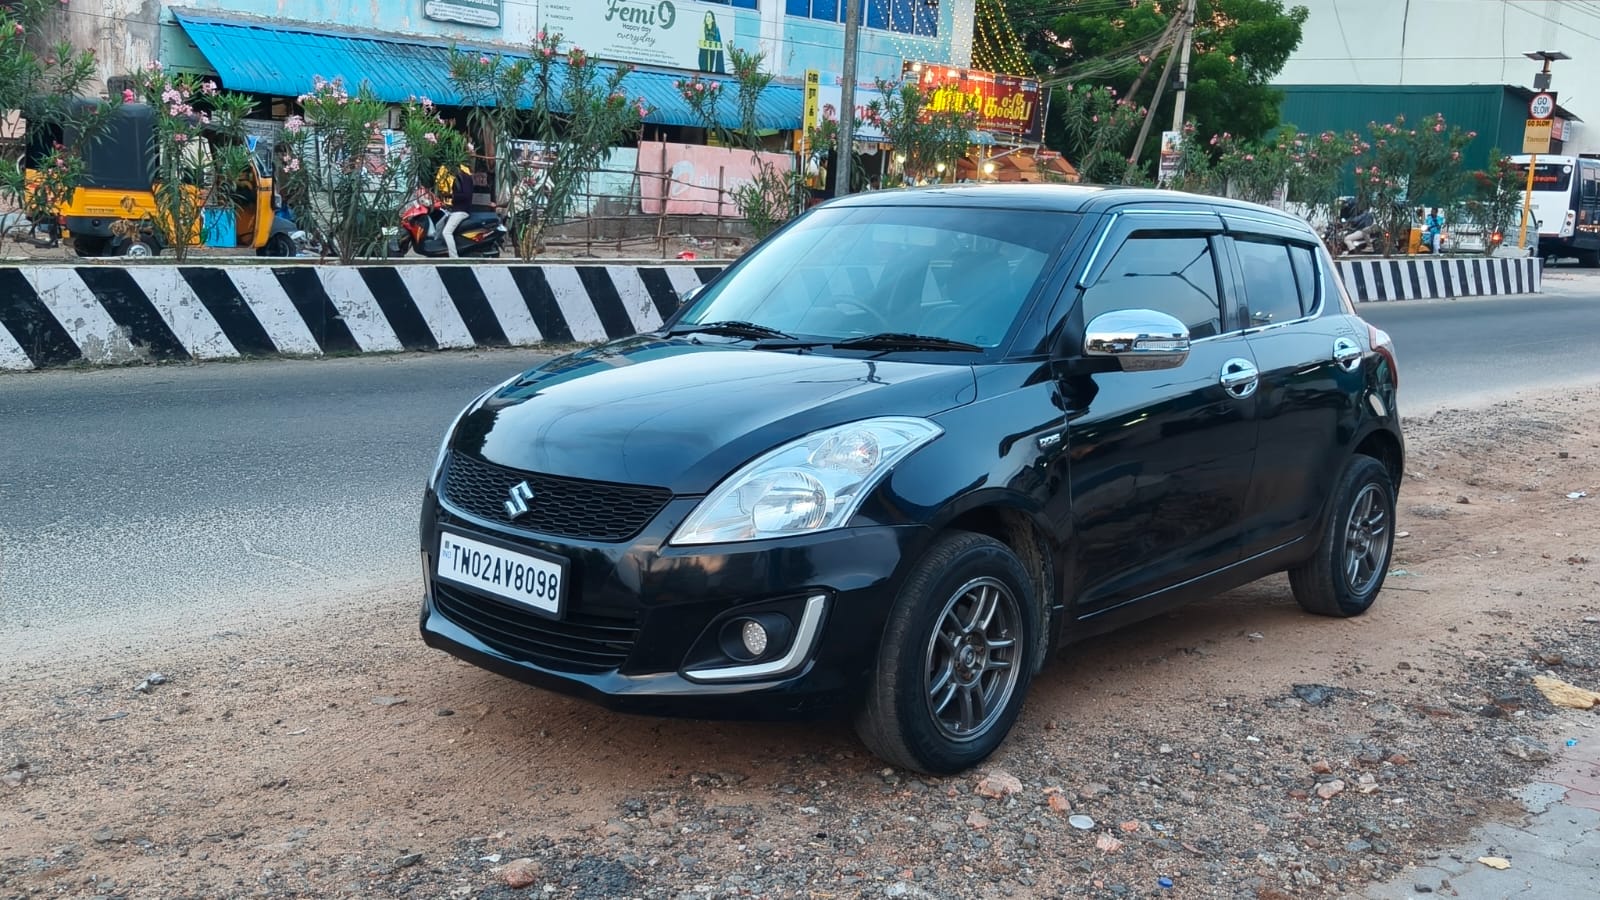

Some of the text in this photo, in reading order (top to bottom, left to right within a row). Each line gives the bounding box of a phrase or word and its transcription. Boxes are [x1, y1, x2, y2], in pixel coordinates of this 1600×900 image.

[622, 22, 640, 32] Happy
[616, 31, 656, 47] everyday
[1537, 96, 1548, 106] GO
[1533, 106, 1549, 114] SLOW
[452, 544, 558, 601] TN02AV8098
